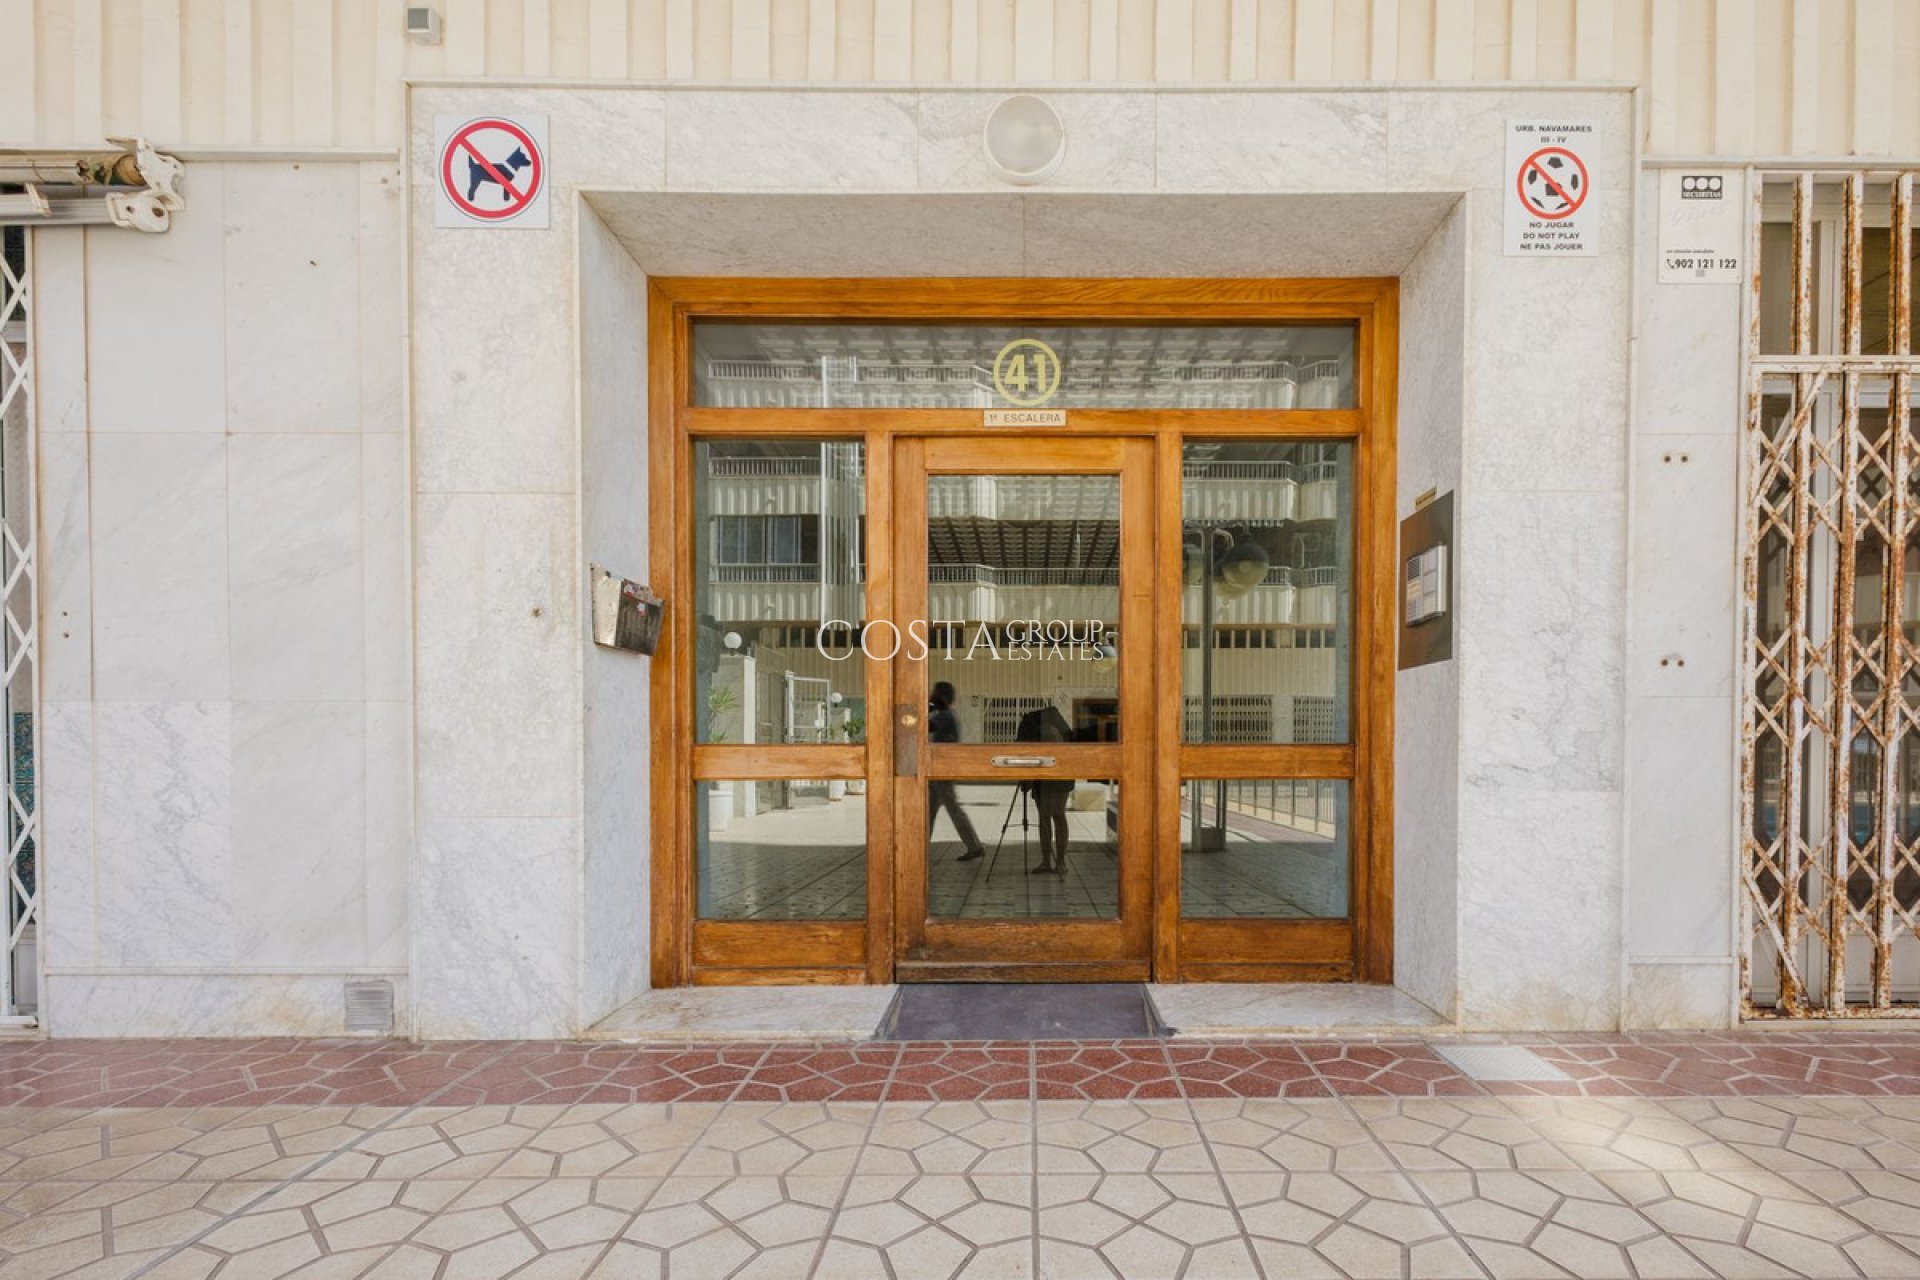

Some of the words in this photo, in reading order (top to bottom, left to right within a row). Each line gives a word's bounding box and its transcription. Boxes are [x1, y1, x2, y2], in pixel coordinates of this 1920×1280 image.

[1675, 259, 1693, 269] 902
[1697, 259, 1714, 269] 121
[1720, 259, 1737, 269] 122
[1004, 354, 1046, 392] 41
[1004, 413, 1061, 423] ESCALERA
